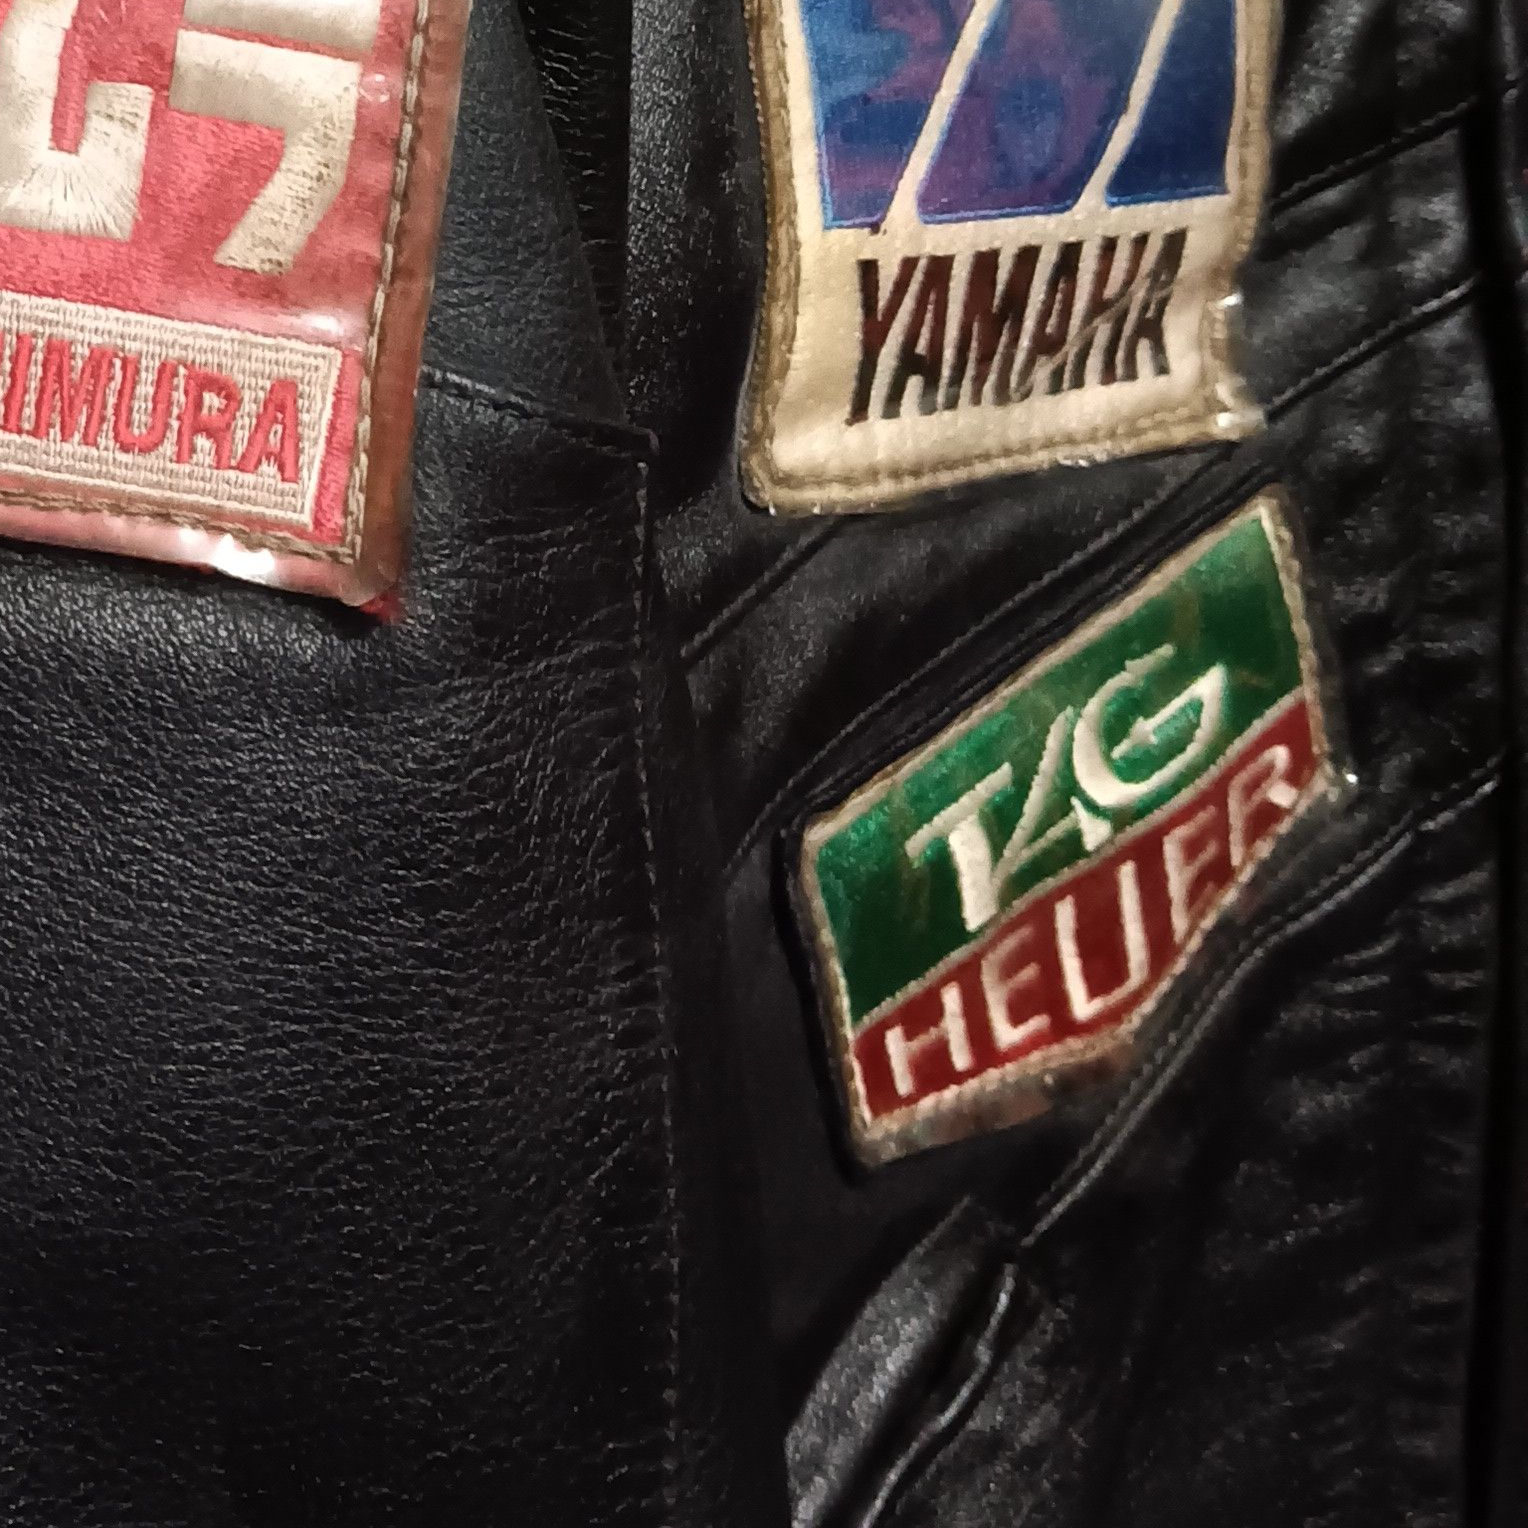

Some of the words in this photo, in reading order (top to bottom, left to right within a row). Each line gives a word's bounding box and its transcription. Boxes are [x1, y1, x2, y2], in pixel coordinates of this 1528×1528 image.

[845, 227, 1188, 428] YAMAHA
[882, 742, 1300, 1098] HEUER
[903, 642, 1228, 934] TAG
